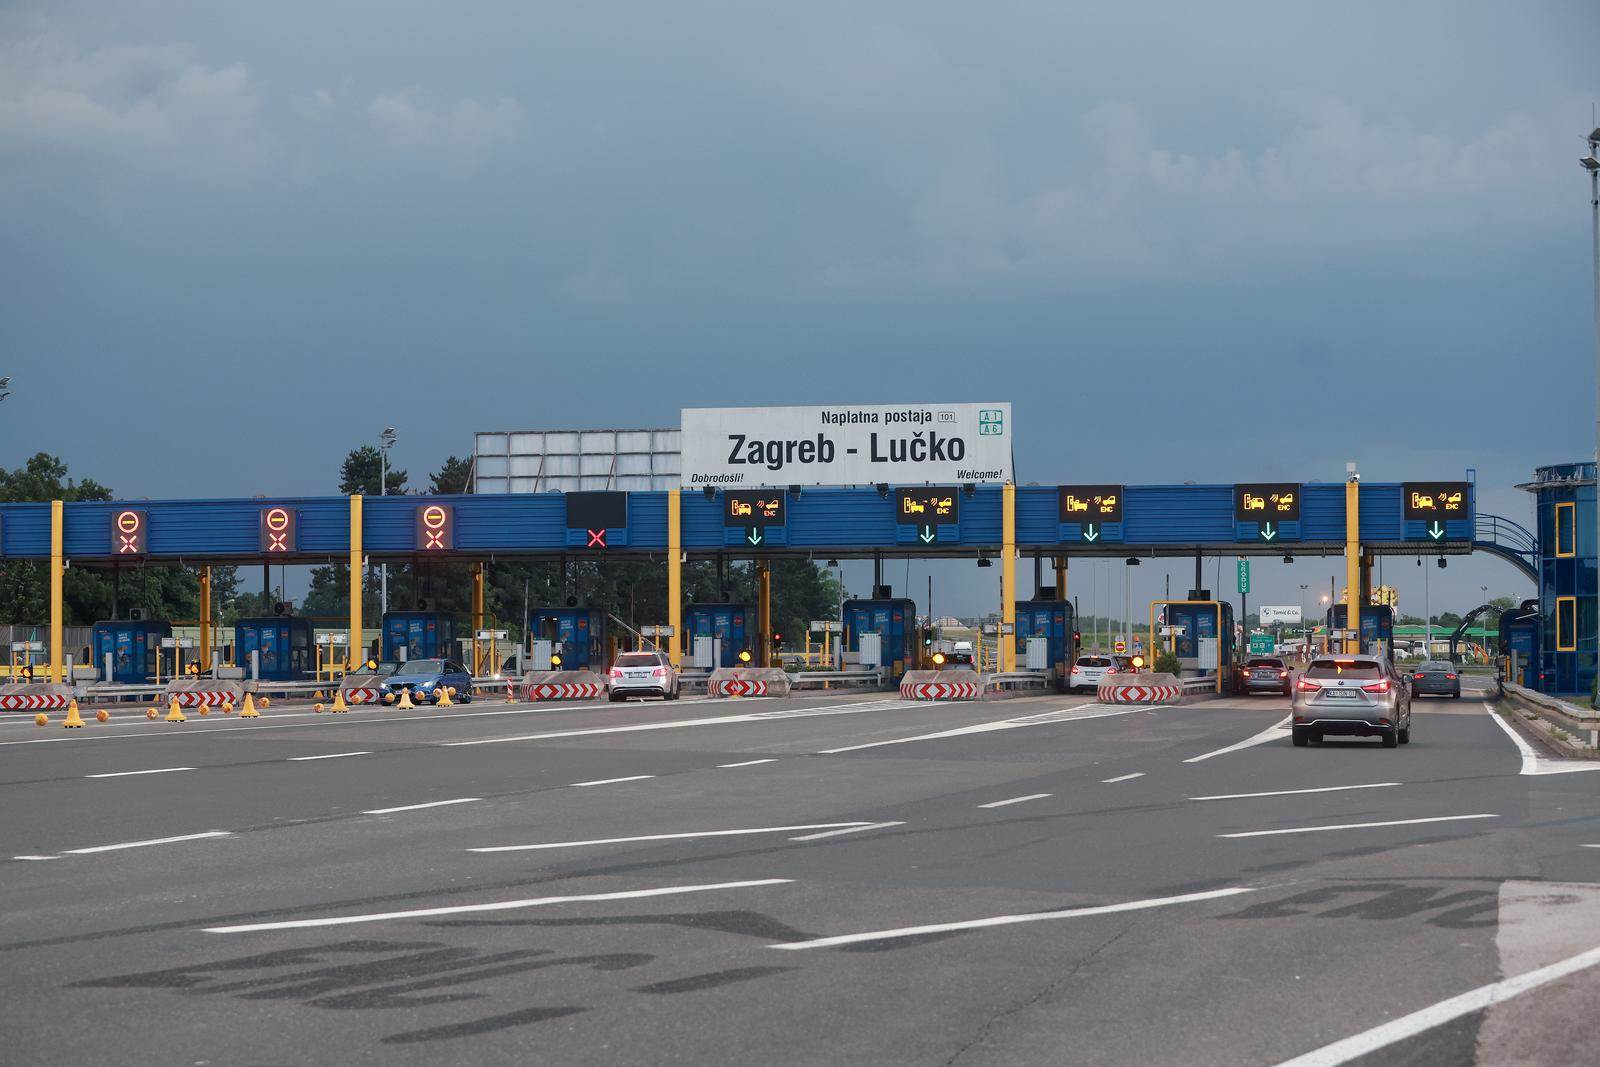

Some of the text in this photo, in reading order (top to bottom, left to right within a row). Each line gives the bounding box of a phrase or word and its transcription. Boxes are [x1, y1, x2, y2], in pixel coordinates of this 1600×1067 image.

[822, 409, 953, 426] Naplatna postaja 101
[728, 433, 834, 470] Zagreb
[870, 431, 965, 463] Lučko
[691, 473, 744, 483] Dobrodošli!
[957, 469, 1002, 479] Welcome!
